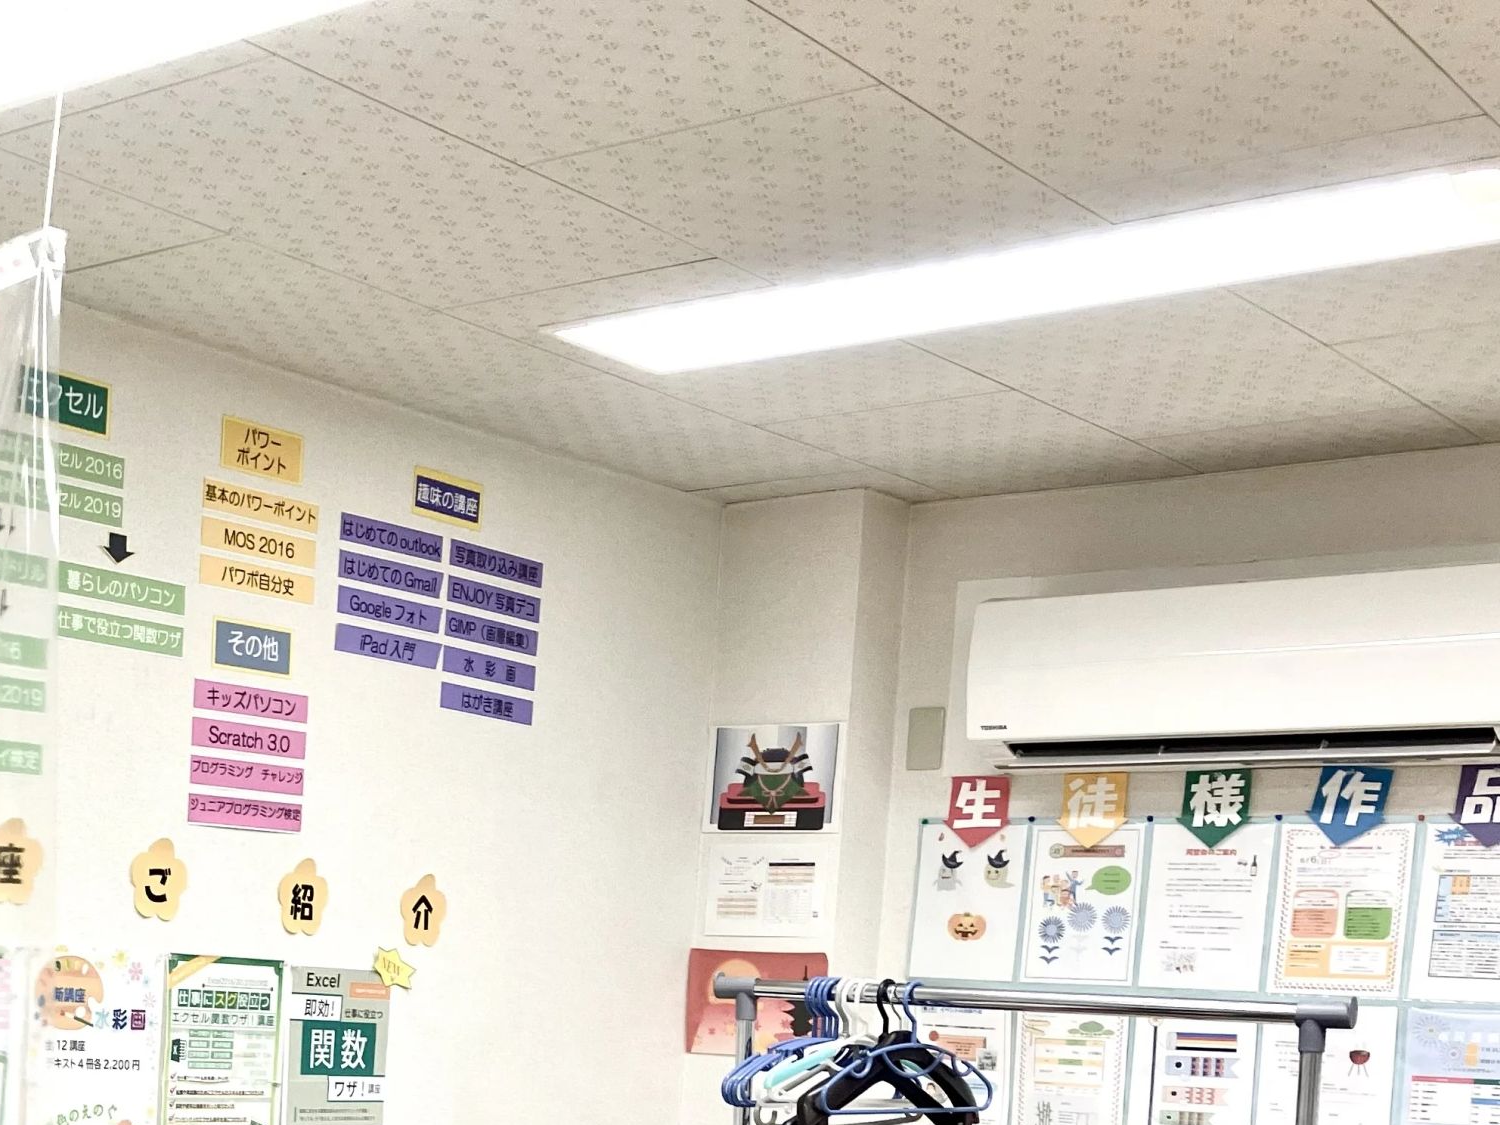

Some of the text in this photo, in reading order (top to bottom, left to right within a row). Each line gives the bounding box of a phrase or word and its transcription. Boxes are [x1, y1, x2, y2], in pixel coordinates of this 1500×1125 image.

[244, 427, 282, 451] パワー
[85, 456, 124, 480] 2016
[236, 447, 287, 474] ポイント
[83, 494, 122, 519] 2019
[205, 484, 316, 526] 基本のパワーポイント
[417, 482, 479, 518] 趣味の講座
[224, 527, 295, 560] MOS 2016
[68, 568, 176, 608] 暮らしのパソコン
[221, 565, 294, 598] パワポ自分史
[58, 610, 183, 650] 仕事で役立つ関数ワザ
[228, 630, 279, 663] その他
[206, 686, 297, 717] キッズパソコン
[208, 725, 291, 754] Scratch 3.0
[190, 796, 301, 823] ジュニアプログラミング検定
[54, 986, 86, 1003] 新講座
[306, 972, 341, 988] Excel
[179, 989, 270, 1009] 仕事にスグ役立つ
[345, 1008, 383, 1019] 仕事に役立つ
[310, 1028, 367, 1070] 関数
